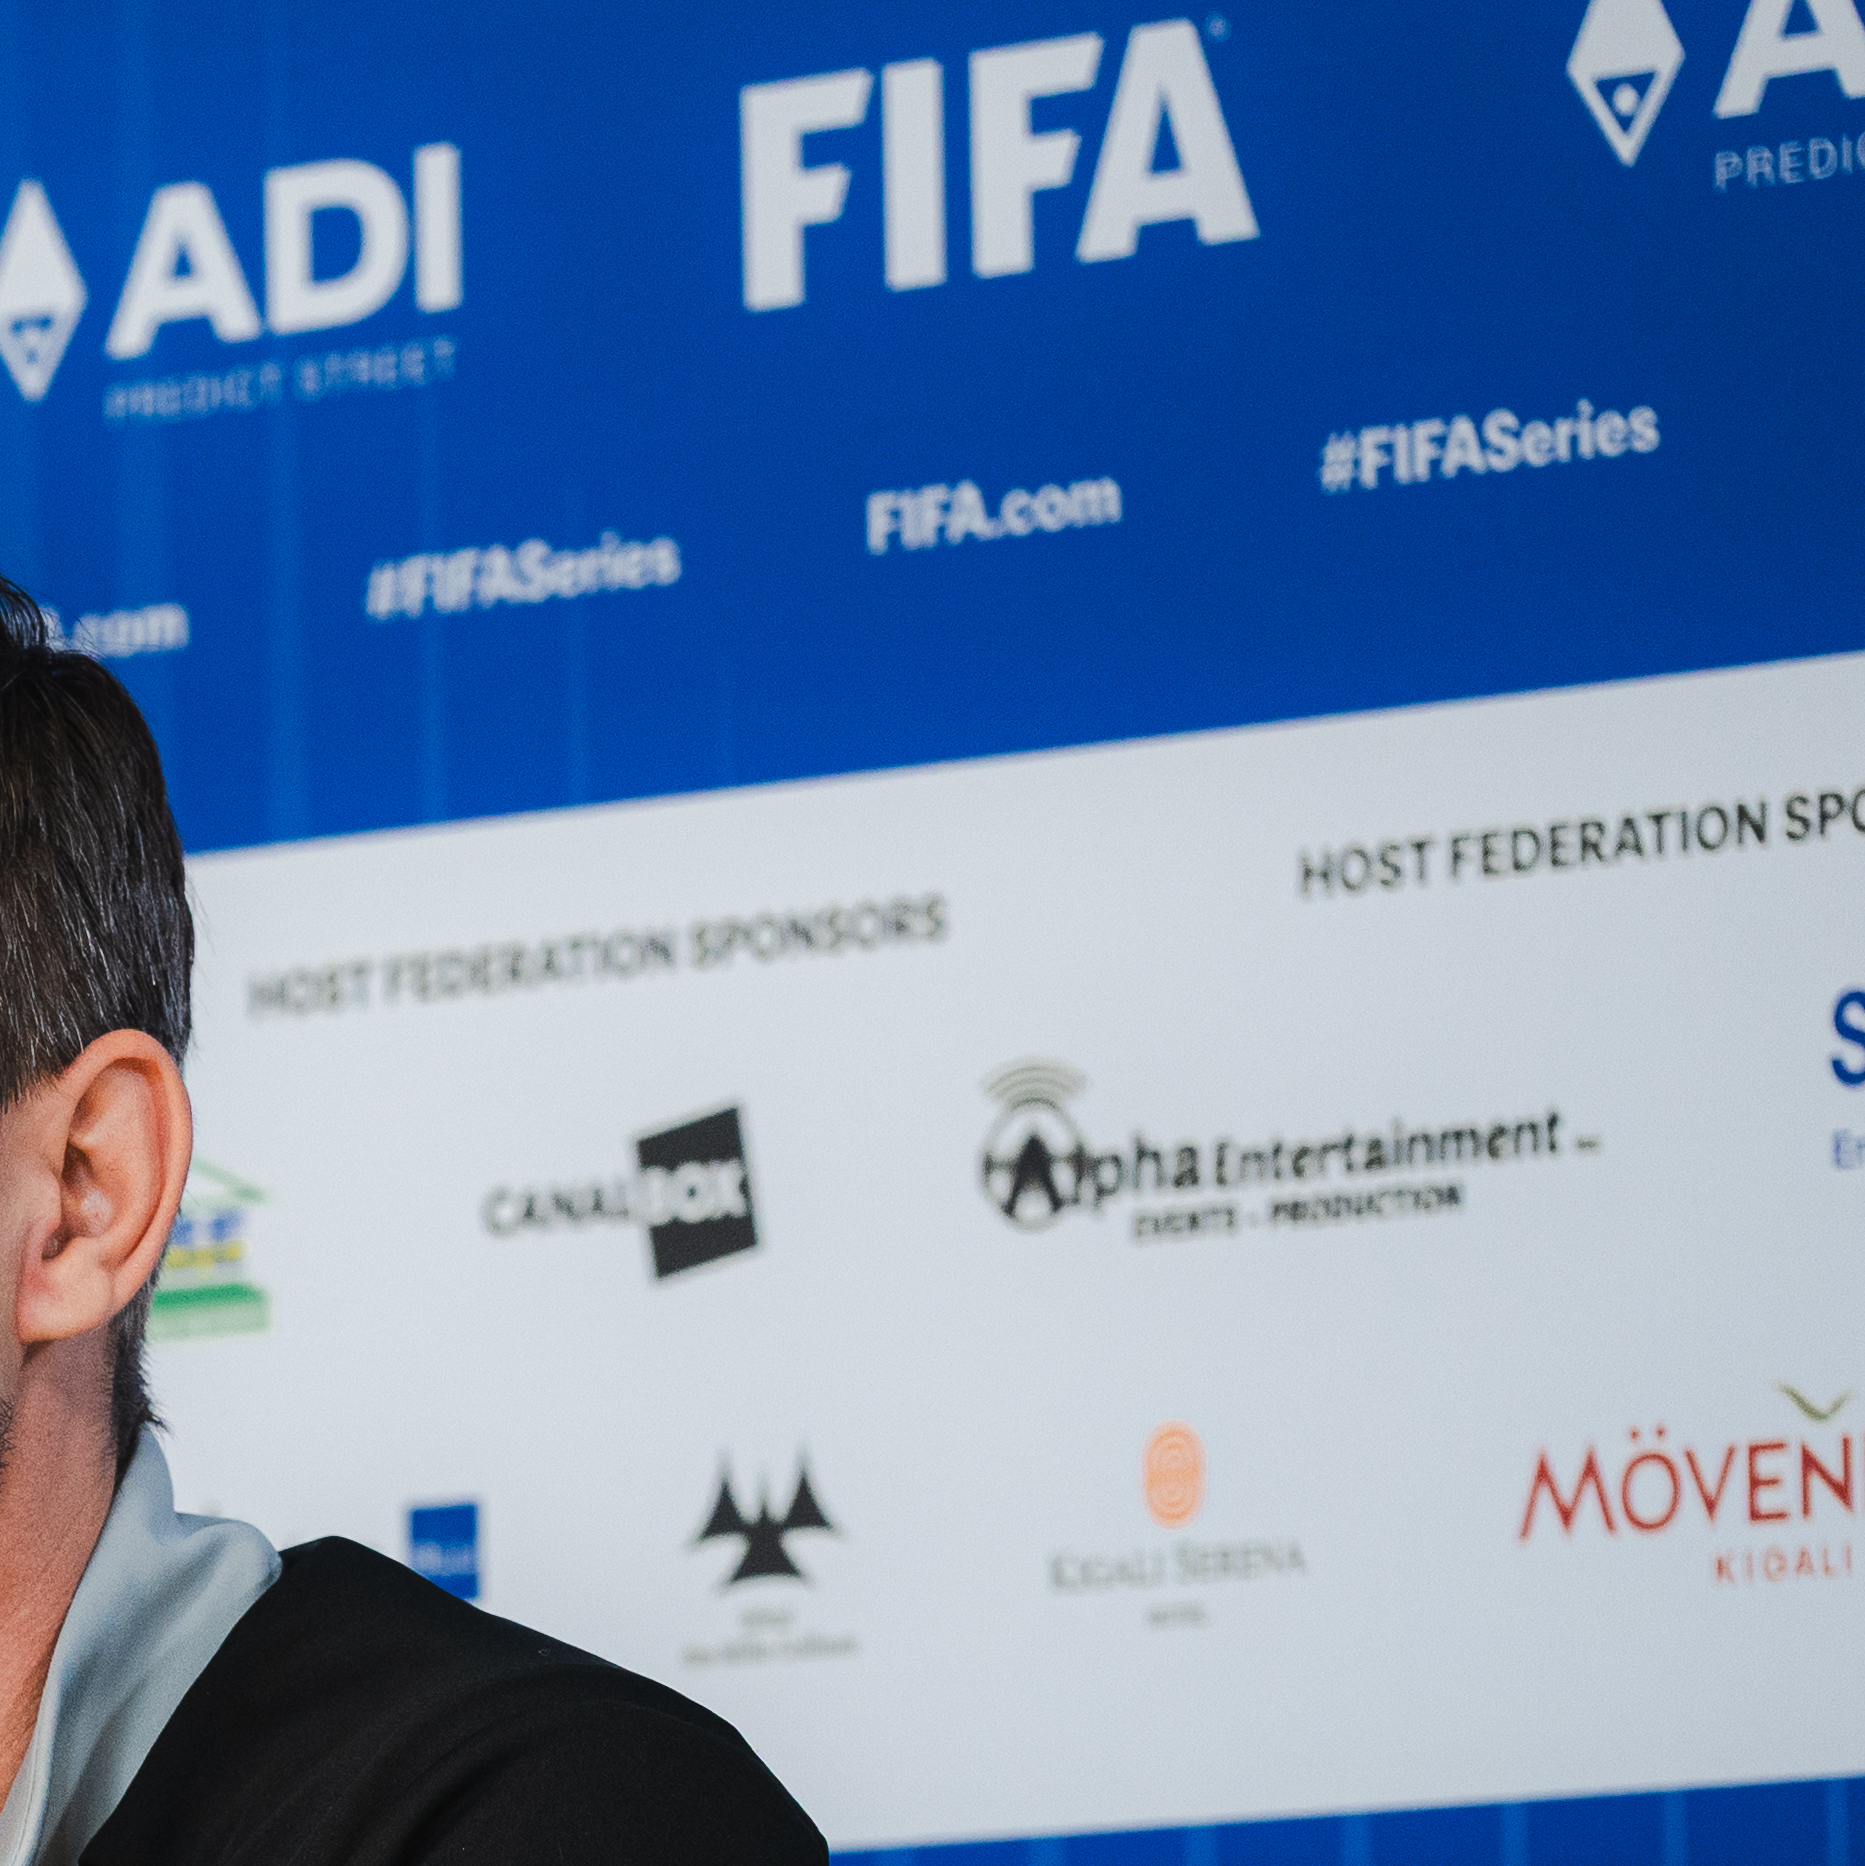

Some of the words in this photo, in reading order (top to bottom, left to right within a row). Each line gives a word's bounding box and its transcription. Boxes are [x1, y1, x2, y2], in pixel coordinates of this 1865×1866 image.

[741, 18, 1259, 312] FIFA
[106, 143, 462, 359] ADI
[1319, 400, 1660, 492] #FIFASeries
[866, 476, 1122, 555] FIFA.com
[365, 532, 681, 620] #FIFASeries
[1299, 839, 1433, 897] HOST
[1450, 799, 1768, 883] FEDERATION
[247, 962, 373, 1015] HOST
[383, 926, 677, 1004] FEDERATION
[689, 893, 949, 969] SPONSORS
[1213, 1112, 1560, 1188] Entertainment
[1516, 1425, 1865, 1544] MÖVEN
[1714, 1542, 1855, 1587] KIGALI
